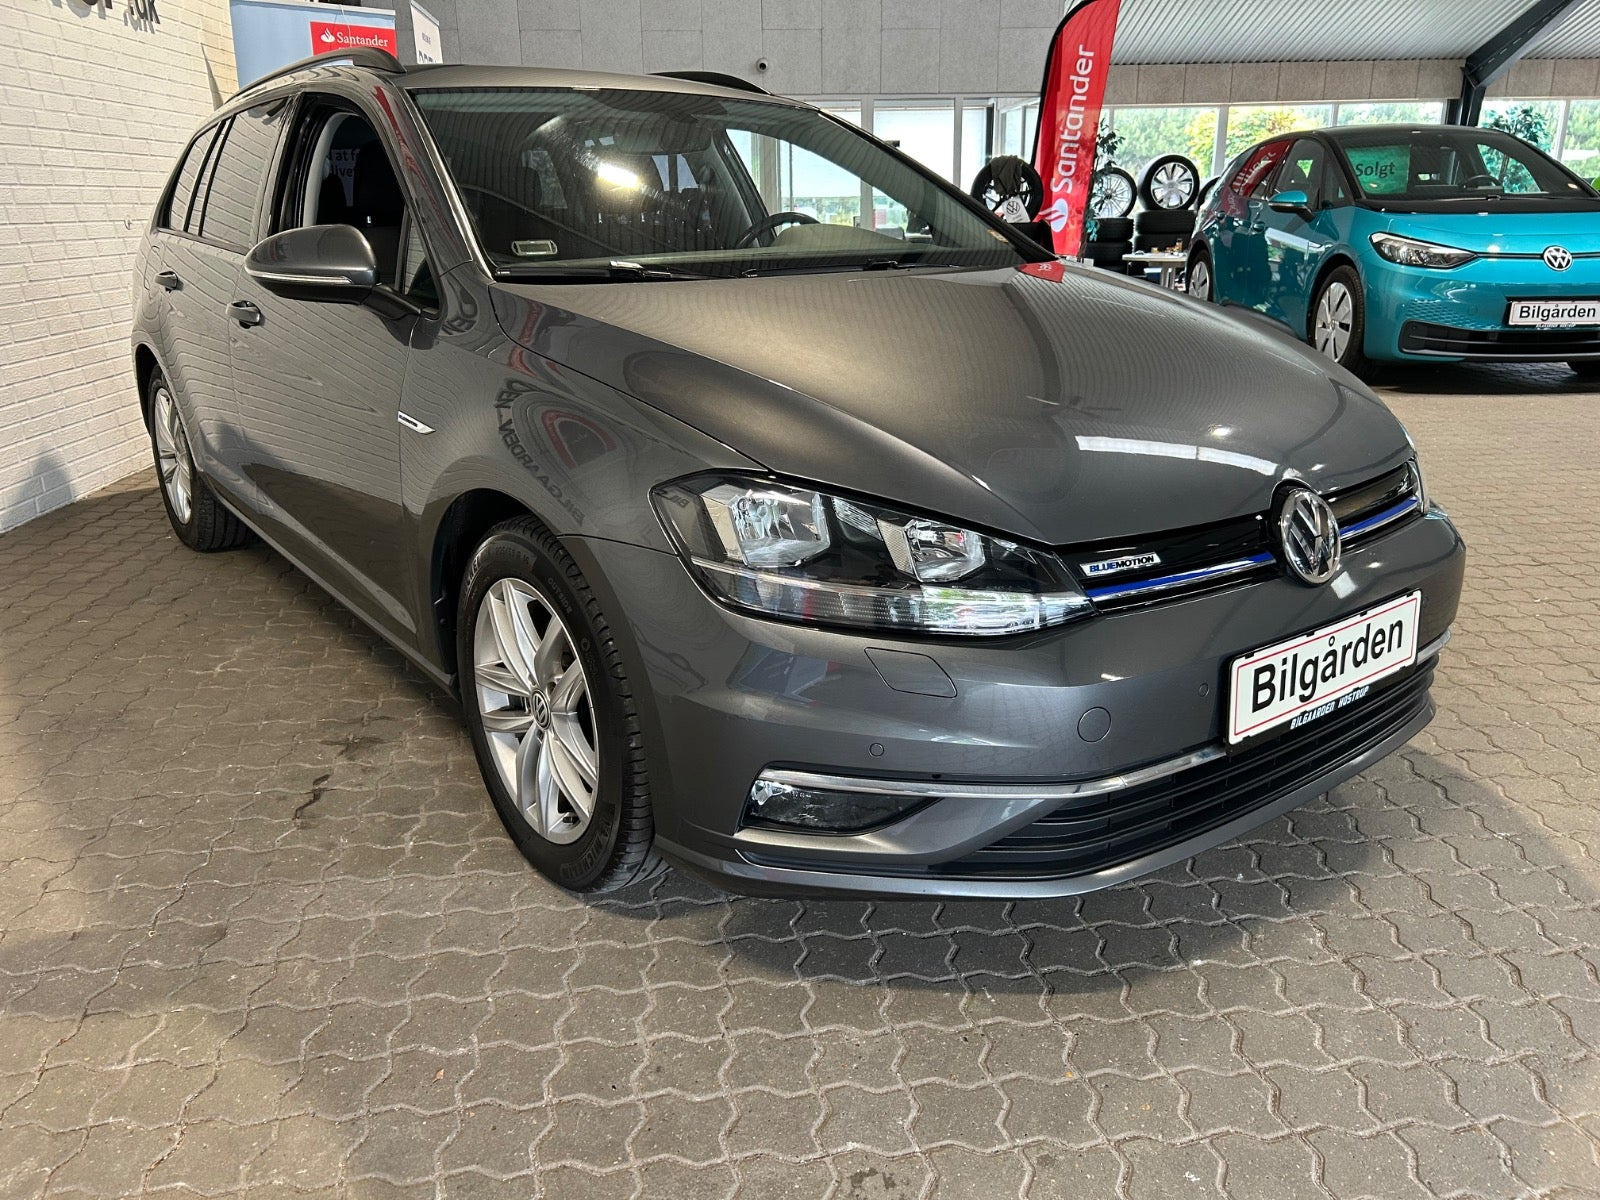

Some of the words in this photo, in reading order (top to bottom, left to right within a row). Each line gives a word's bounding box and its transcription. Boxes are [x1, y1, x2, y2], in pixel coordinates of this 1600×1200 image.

[336, 31, 389, 48] Santander
[1049, 44, 1096, 195] Santander
[1355, 160, 1396, 179] Solgt
[1519, 303, 1597, 322] Bilgården
[1088, 555, 1155, 573] BLUEMOTION
[1251, 618, 1404, 715] Bilgården
